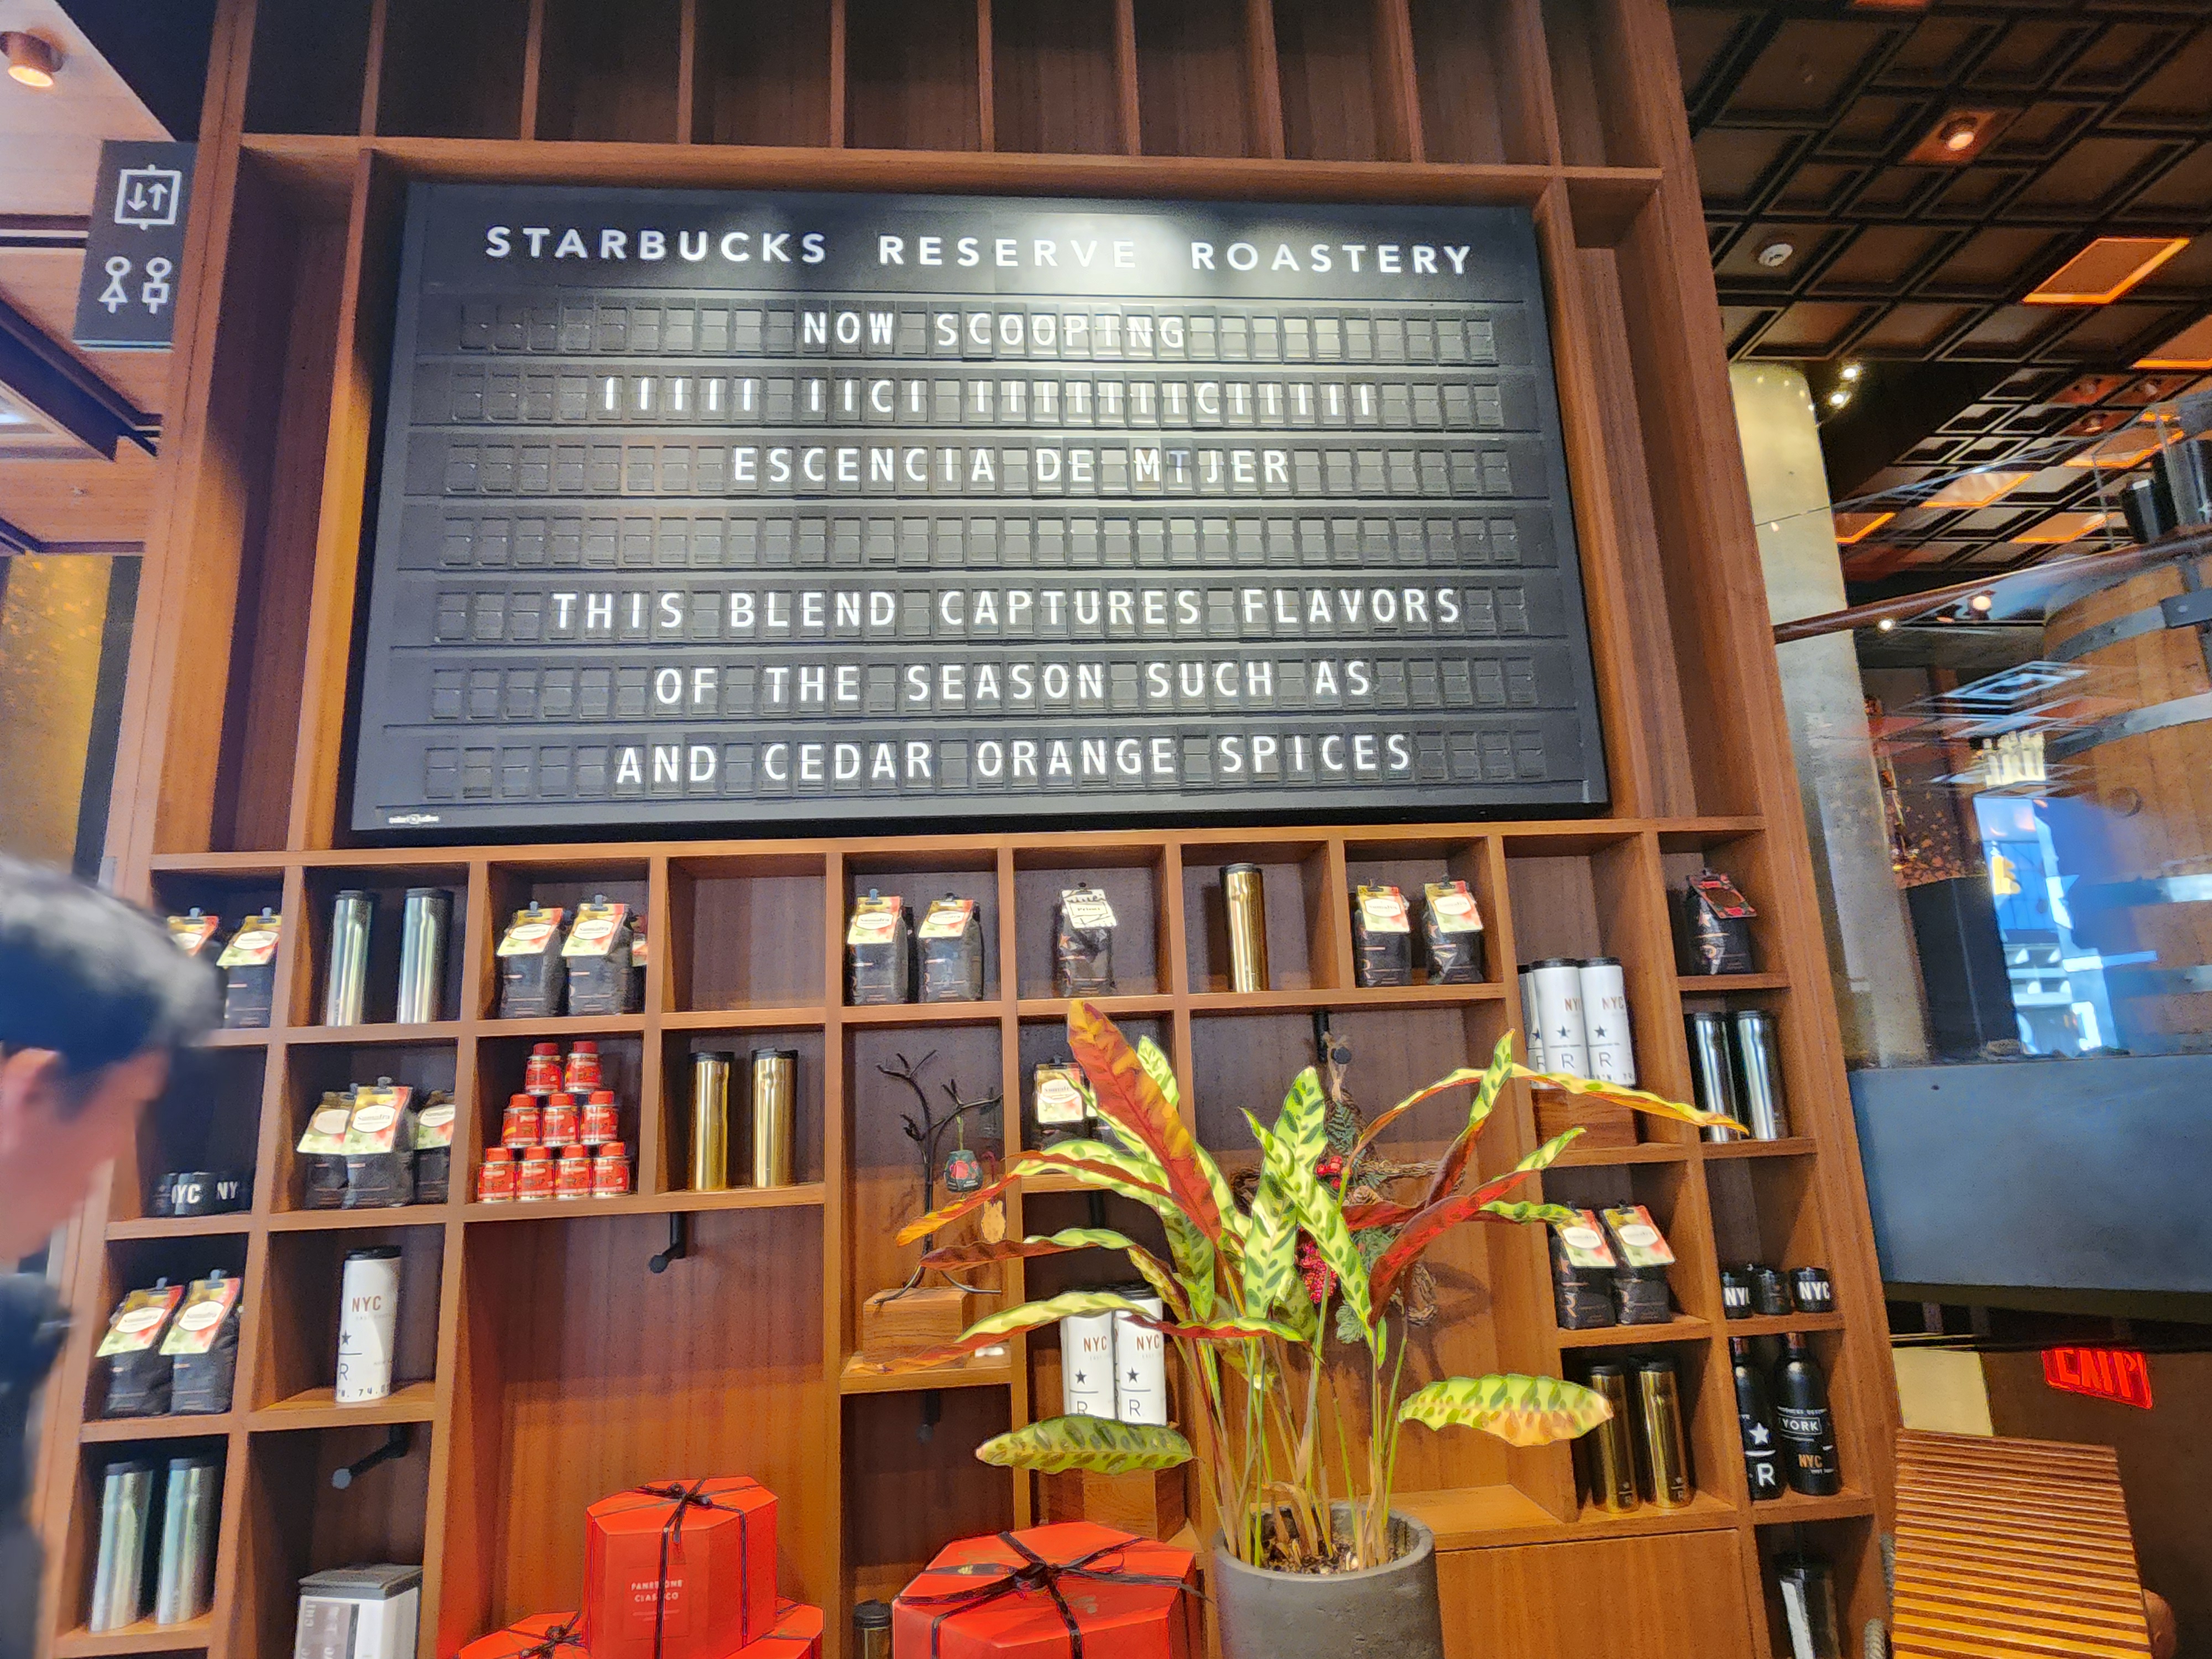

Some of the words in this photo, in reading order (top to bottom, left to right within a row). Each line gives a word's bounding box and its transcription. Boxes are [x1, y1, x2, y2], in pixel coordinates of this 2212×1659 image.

[487, 227, 826, 263] STARBUCKS
[879, 236, 1135, 268] RESERVE
[1191, 242, 1470, 274] ROASTERY
[804, 311, 893, 344] NOW
[937, 313, 1184, 348] SCOOPING
[735, 448, 994, 482] ESCENCIA
[1037, 449, 1092, 481] DE
[554, 593, 682, 628] THIS
[731, 592, 895, 628] BLEND
[941, 591, 1198, 624] CAPTURES
[1244, 589, 1458, 623] FLAVORS
[656, 668, 714, 704] OF
[766, 666, 858, 702] THE
[908, 665, 1103, 701] SEASON
[1149, 662, 1271, 697] SUCH
[1316, 661, 1369, 695] AS
[616, 746, 715, 783] AND
[765, 742, 931, 780] CEDAR
[978, 739, 1174, 776] ORANGE
[1221, 735, 1408, 772] SPICES
[1602, 997, 1624, 1010] NYC
[1561, 1053, 1575, 1068] R
[1599, 1052, 1612, 1067] R
[1799, 1281, 1830, 1300] NYC
[352, 1296, 381, 1312] NYC
[1083, 1336, 1107, 1352] NYC
[1136, 1334, 1160, 1351] NYC
[339, 1363, 348, 1380] R
[1129, 1399, 1140, 1416] R
[1782, 1417, 1818, 1431] YORK
[1798, 1454, 1823, 1468] NYC
[1757, 1463, 1776, 1487] R
